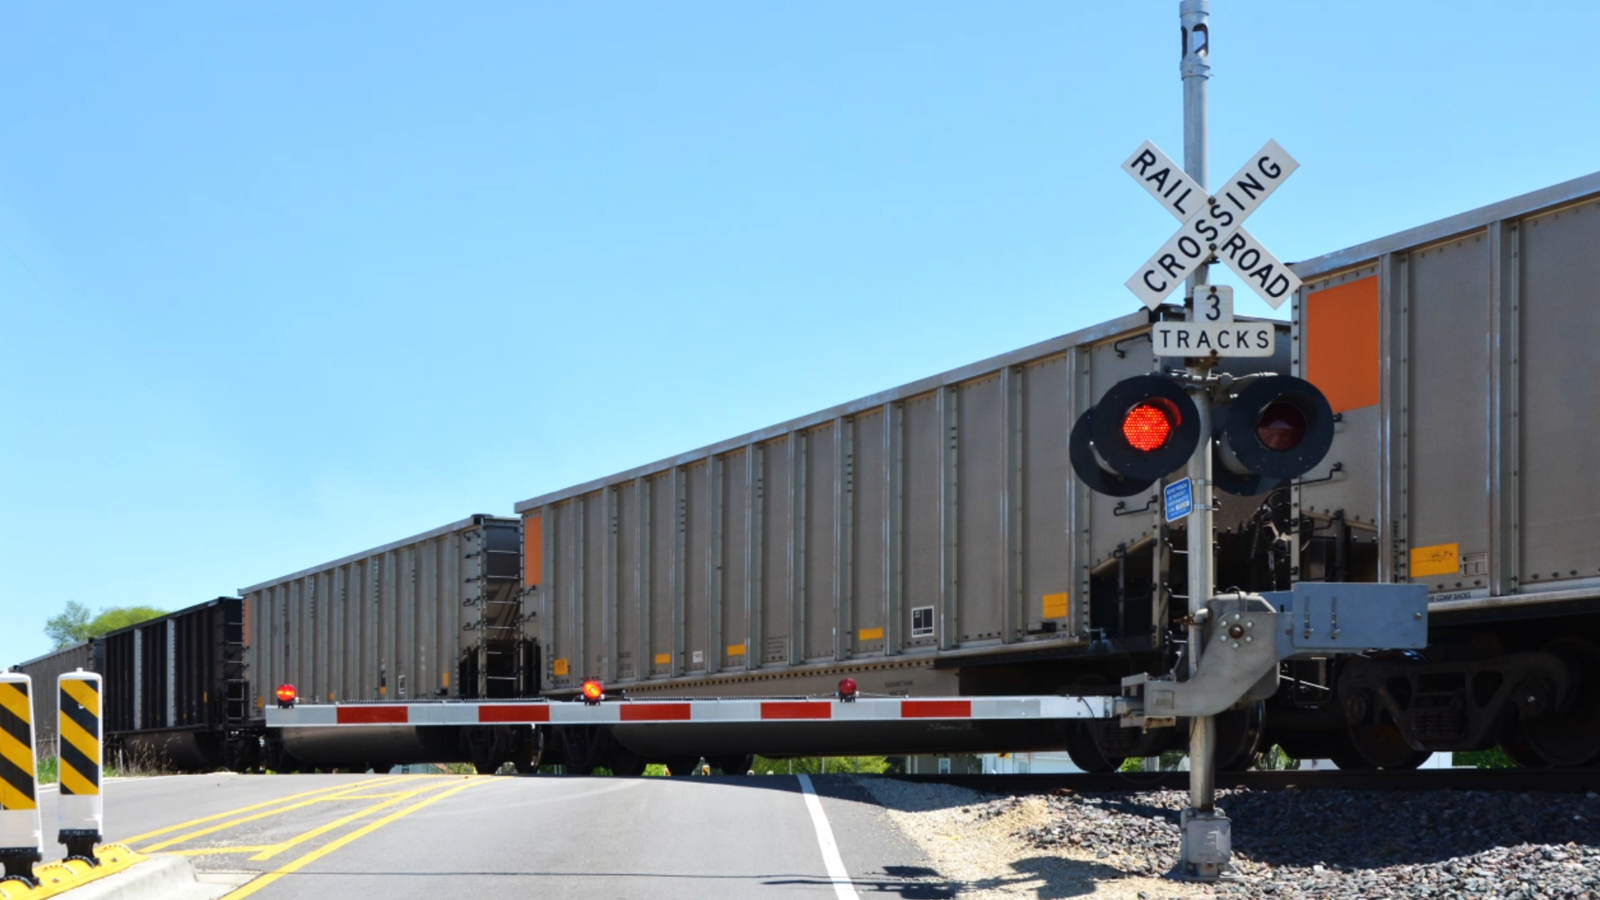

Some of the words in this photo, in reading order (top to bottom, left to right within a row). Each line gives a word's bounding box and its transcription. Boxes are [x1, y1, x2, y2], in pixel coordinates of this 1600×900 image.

[1130, 148, 1192, 215] RAIL
[1143, 156, 1282, 293] CROSSING
[1221, 233, 1290, 299] ROAD
[1159, 330, 1269, 349] TRACKS
[1205, 294, 1221, 321] 3
